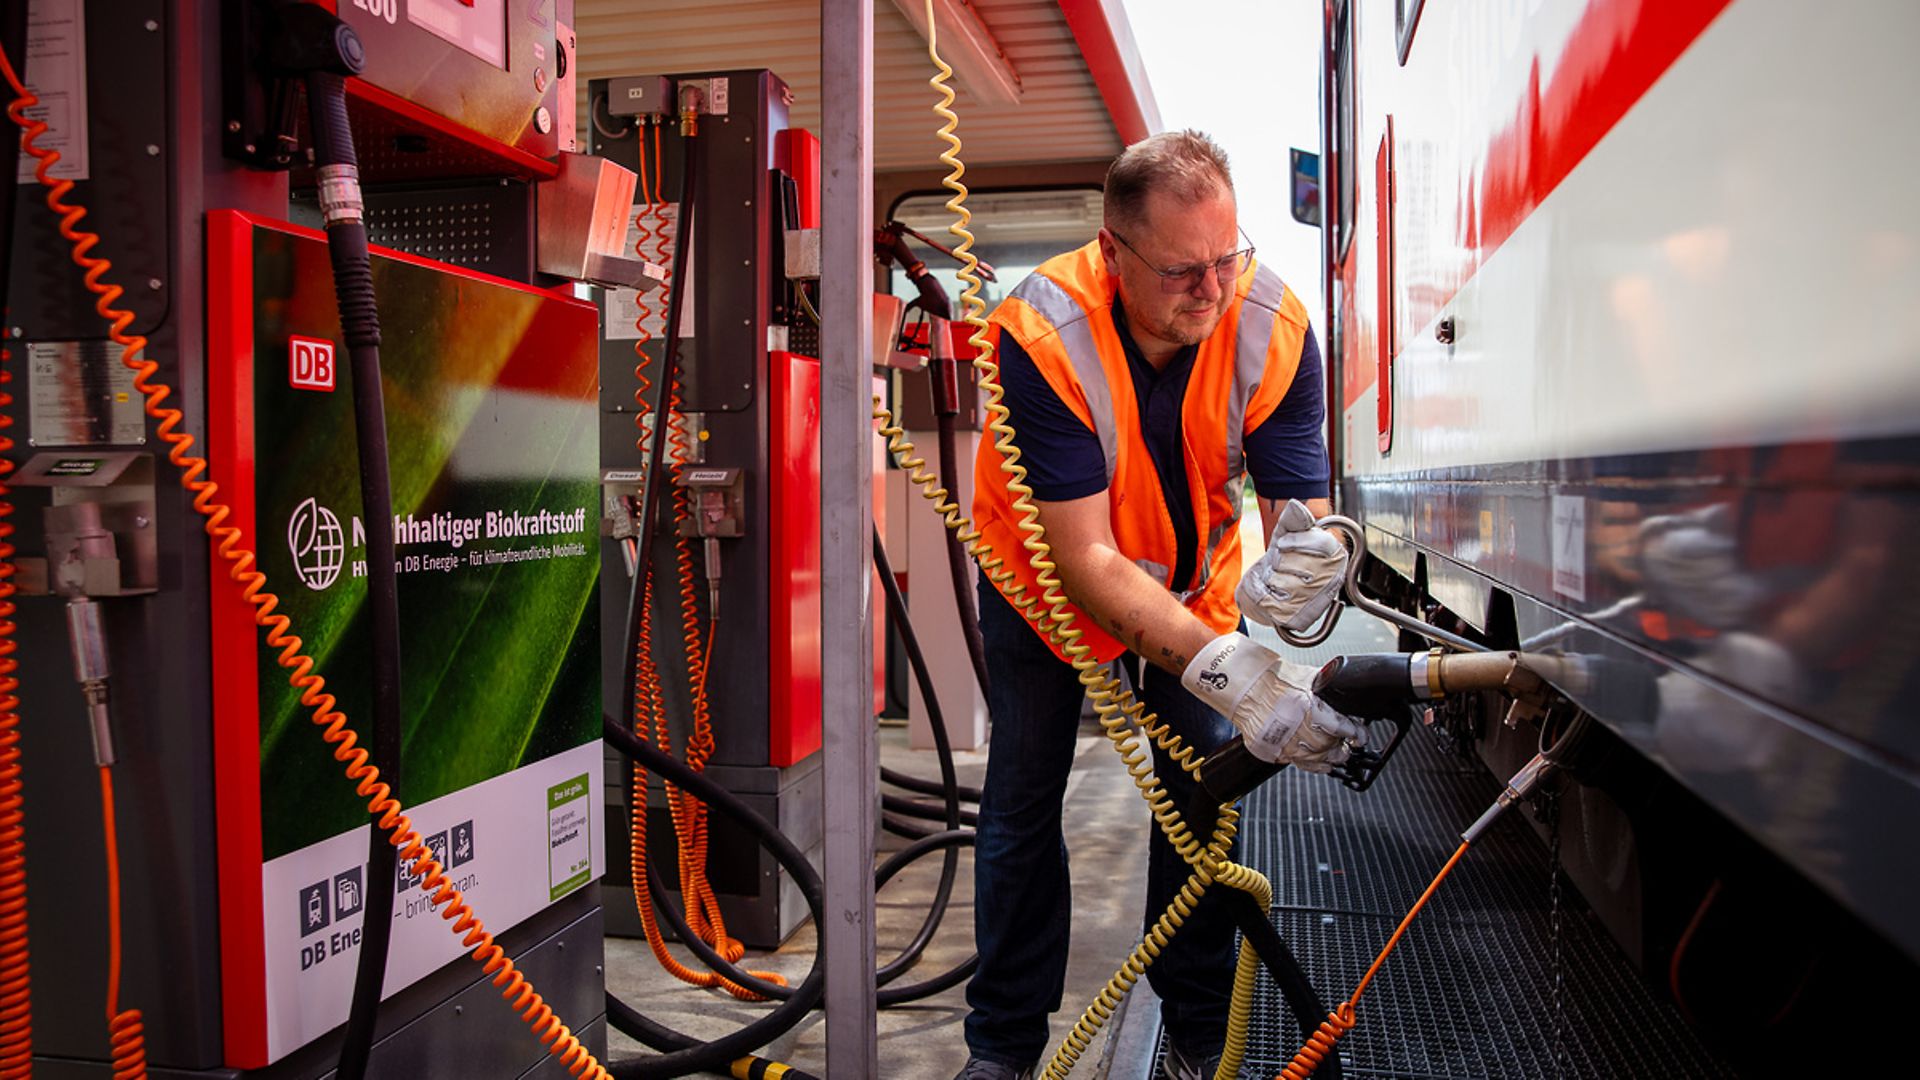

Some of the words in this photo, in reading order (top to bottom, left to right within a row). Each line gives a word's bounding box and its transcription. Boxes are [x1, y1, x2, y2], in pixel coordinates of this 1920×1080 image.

[295, 343, 331, 383] DB
[352, 511, 482, 548] Nhhaltiger
[485, 508, 586, 538] Biokraftstoff
[404, 555, 420, 572] DB
[423, 552, 459, 573] Energie
[469, 550, 483, 566] für
[484, 545, 551, 564] klimafreundliche
[301, 939, 326, 972] DB
